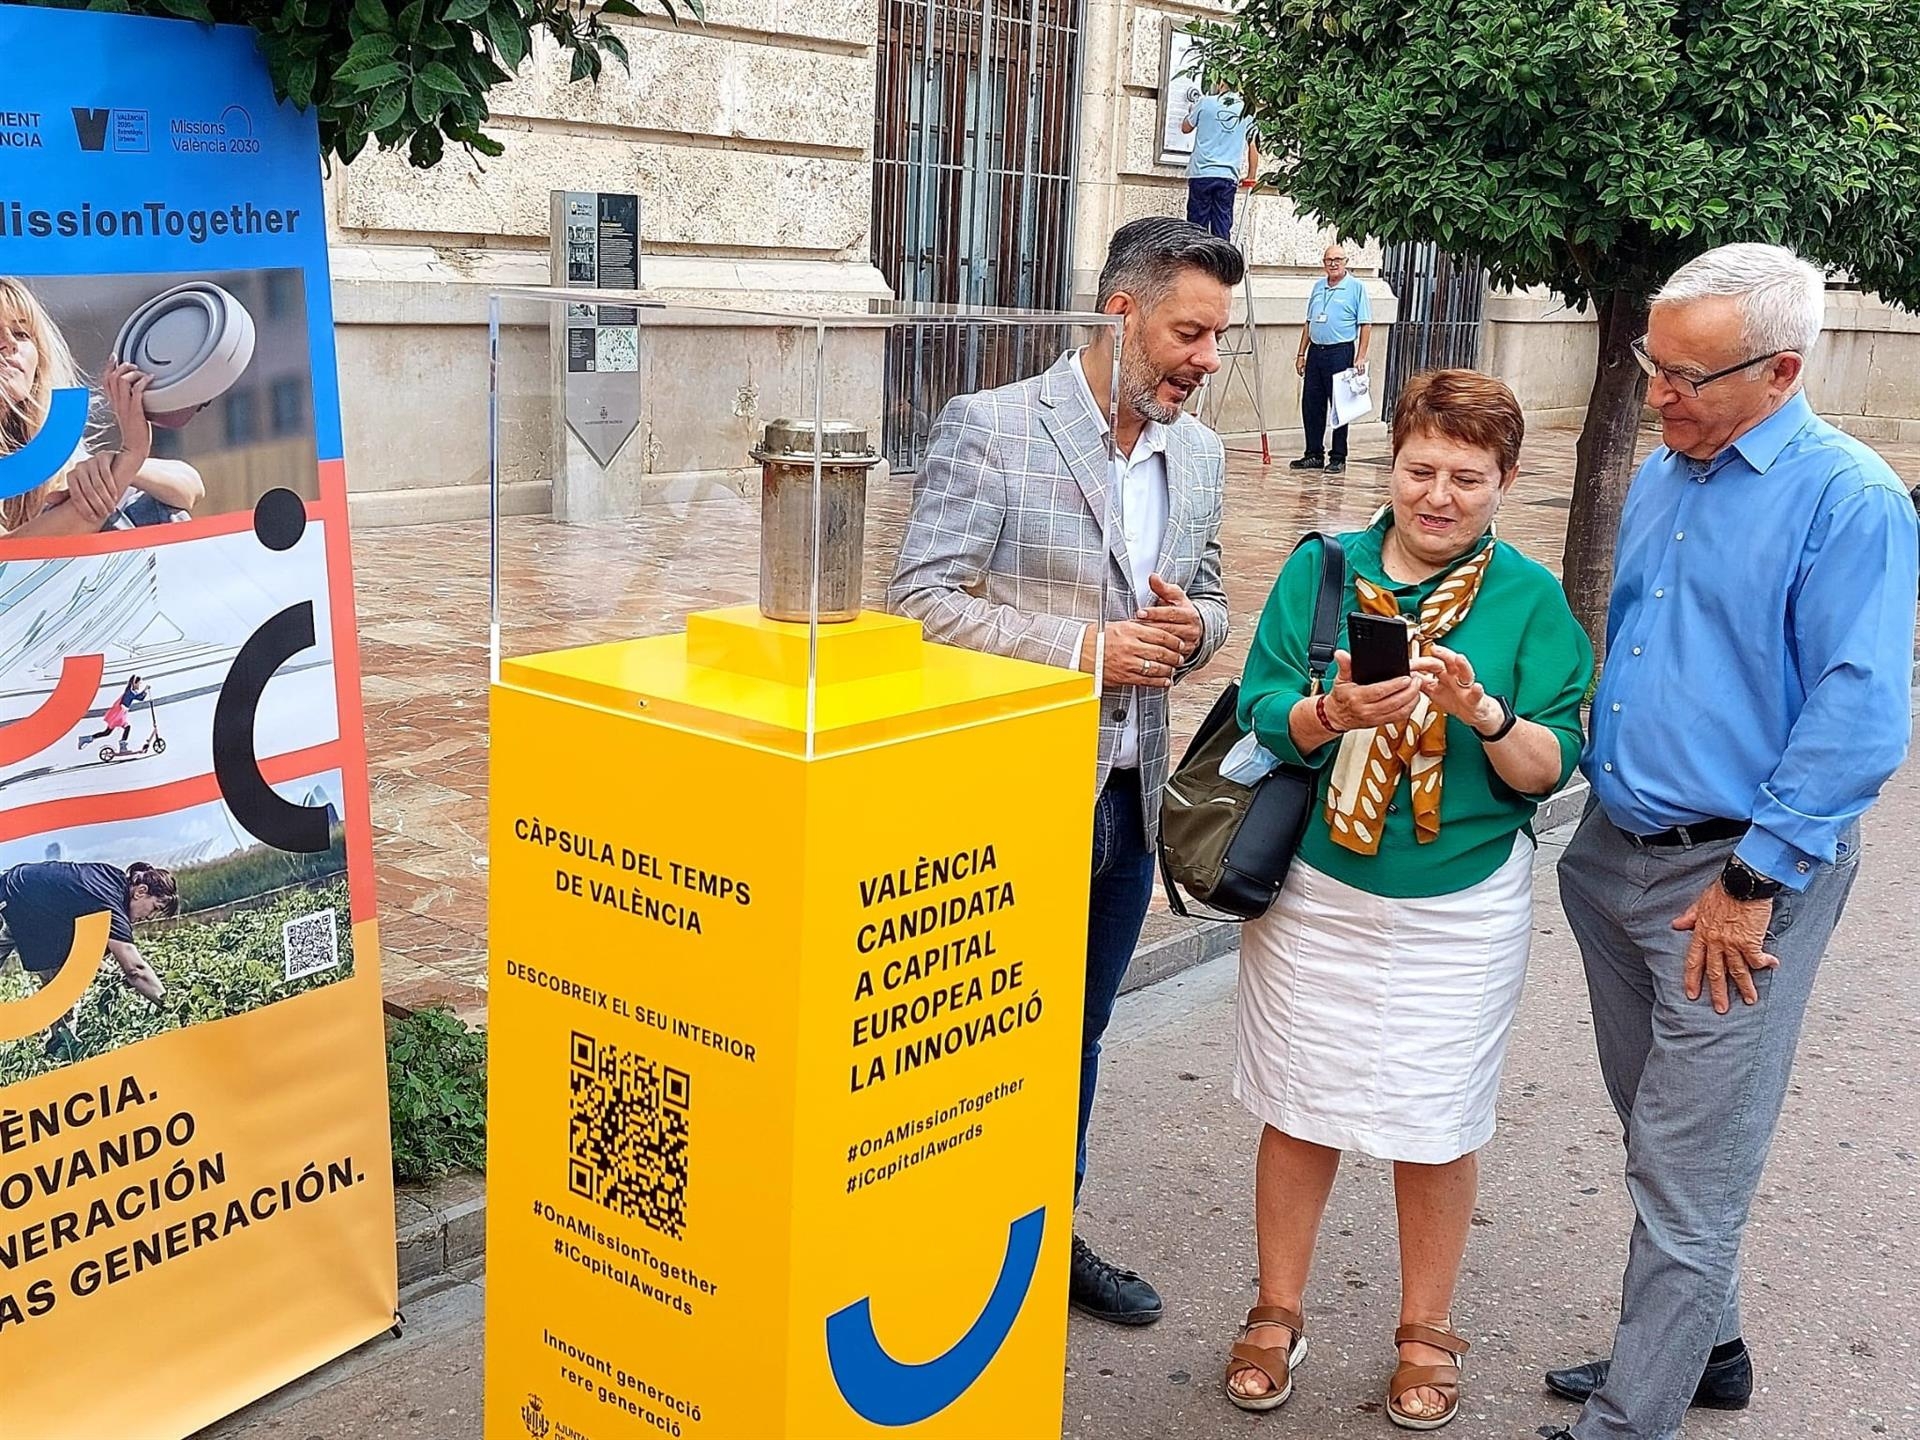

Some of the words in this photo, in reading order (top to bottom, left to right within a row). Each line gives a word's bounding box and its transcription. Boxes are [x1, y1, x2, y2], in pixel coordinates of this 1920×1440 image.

[171, 119, 225, 135] Missions
[172, 137, 227, 152] València
[230, 139, 260, 153] 2030
[0, 202, 300, 243] issionTogether
[515, 817, 616, 866] CÀPSULA
[622, 848, 663, 880] DEL
[669, 861, 752, 906] TEMPS
[858, 844, 998, 908] VALÈNCIA
[556, 870, 584, 897] DE
[589, 879, 703, 935] VALÈNCIA
[856, 881, 1016, 955] CANDIDATA
[852, 976, 984, 1048] EUROPEA
[990, 961, 1025, 996] DE
[854, 971, 875, 1002] A
[882, 930, 997, 992] CAPITAL
[506, 960, 608, 1010] DESCOBREIX
[612, 997, 631, 1018] EL
[634, 1005, 668, 1031] SEU
[672, 1018, 757, 1063] INTERIOR
[850, 1055, 887, 1094] LA
[894, 989, 1044, 1076] INNOVACIÓ
[0, 1075, 158, 1152] ÈNCIA.
[846, 1078, 1026, 1163] #OnAMissionTogether
[0, 1112, 196, 1211] OVANDO
[846, 1123, 984, 1194] #iCapitalAwards
[70, 1157, 366, 1297] GENERACIÓN.
[533, 1200, 718, 1296] #OnAMissionTogether
[554, 1238, 694, 1316] #iCapitalAwards
[543, 1328, 612, 1376] Innovant
[617, 1370, 702, 1422] generació
[561, 1366, 594, 1392] rere
[598, 1386, 682, 1438] generació
